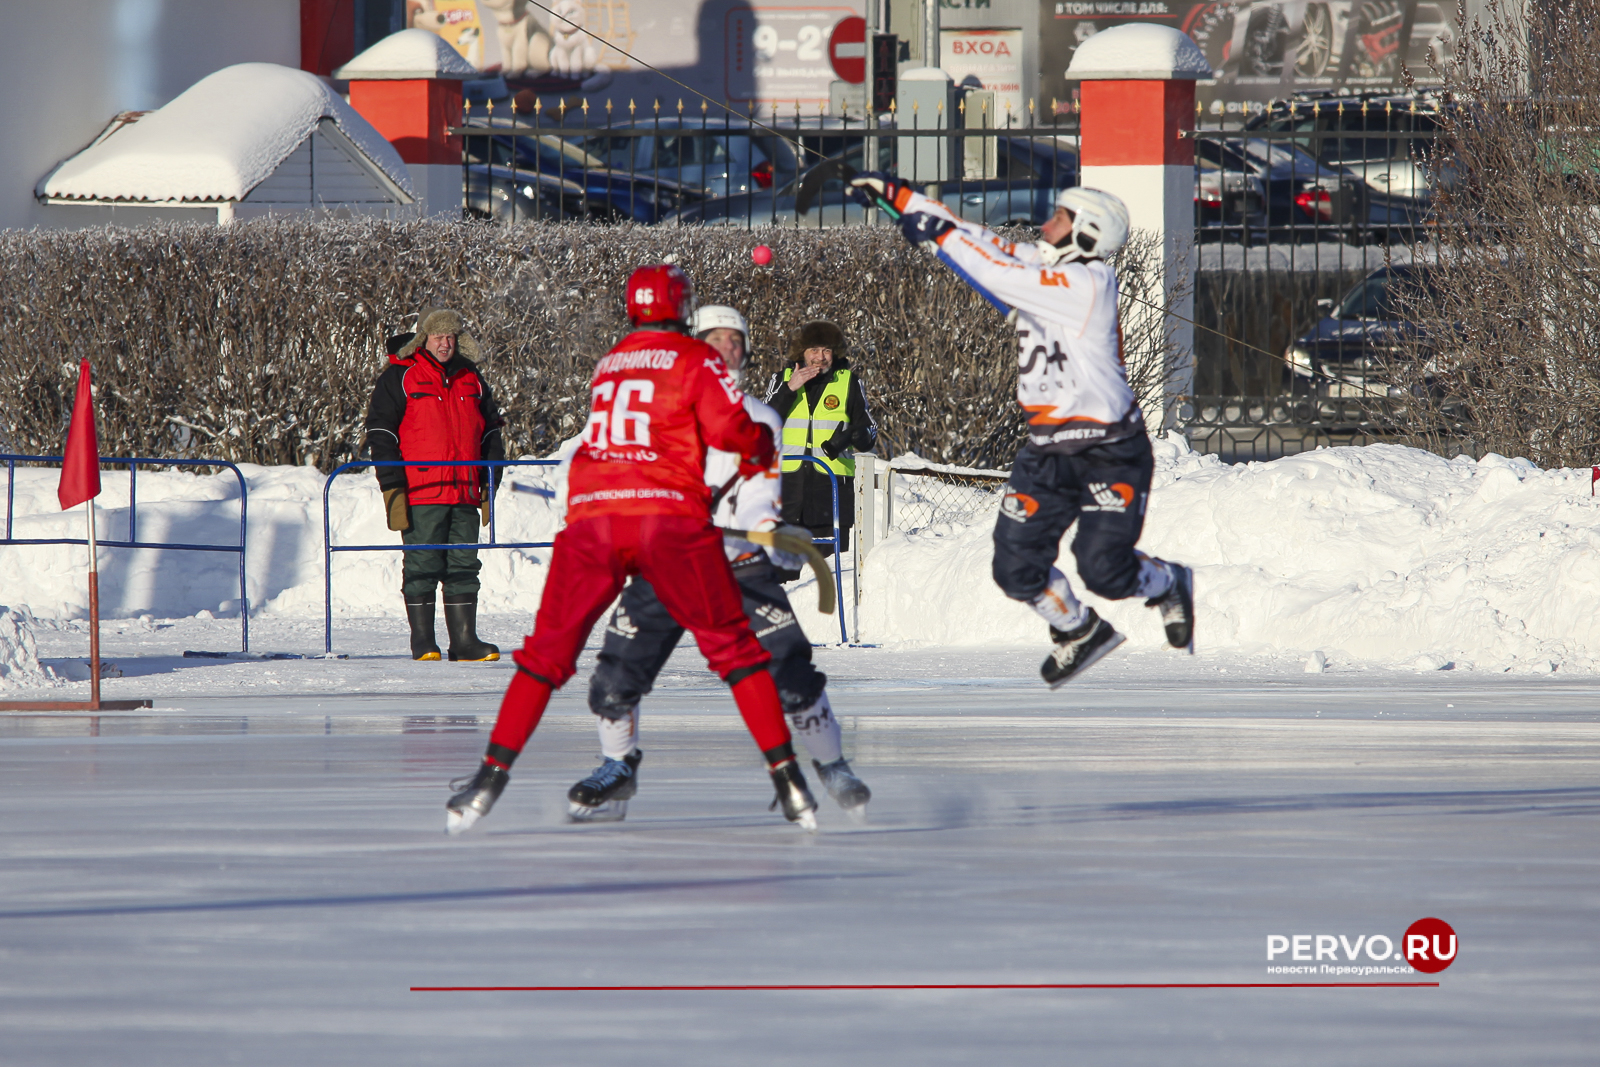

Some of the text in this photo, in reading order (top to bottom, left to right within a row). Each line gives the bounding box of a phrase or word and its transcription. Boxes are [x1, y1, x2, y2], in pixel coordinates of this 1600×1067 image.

[1055, 2, 1168, 15] В ТОМ ЧИСЛЕ ДЛЯ:
[952, 41, 1012, 57] ВХОД
[635, 288, 654, 305] 66
[581, 379, 655, 450] 66
